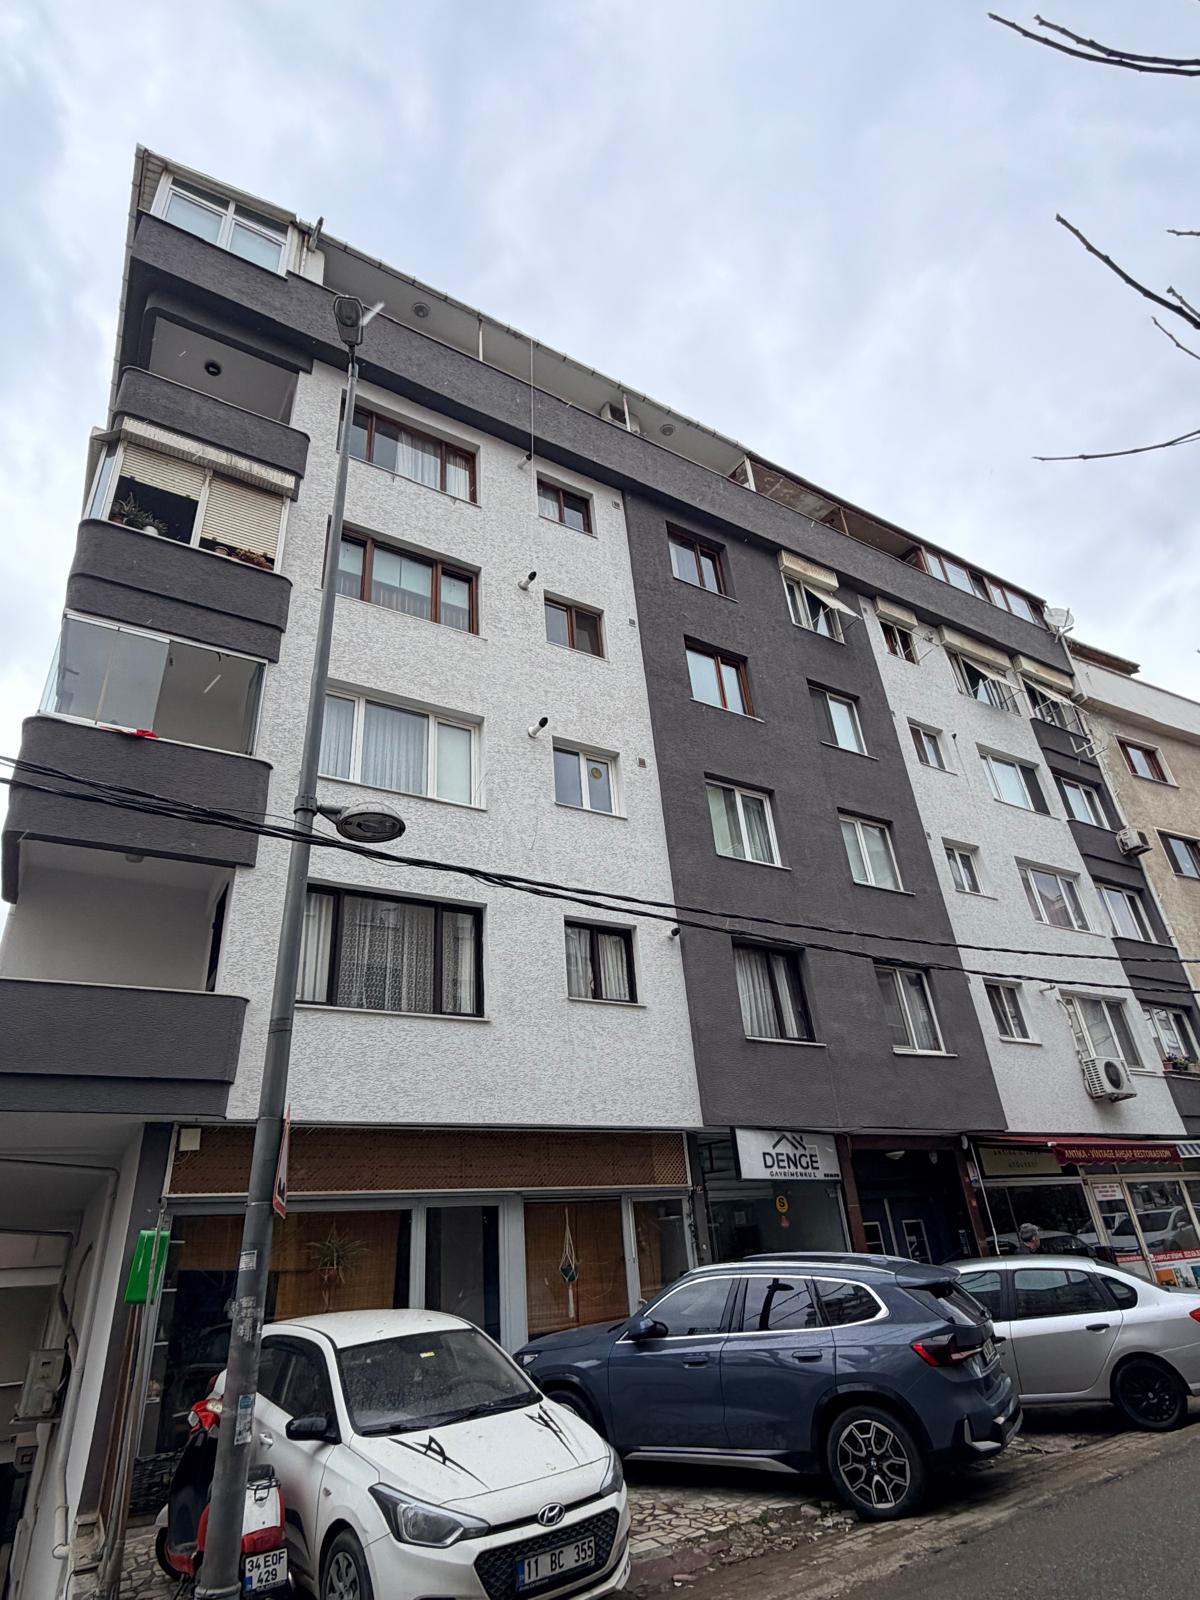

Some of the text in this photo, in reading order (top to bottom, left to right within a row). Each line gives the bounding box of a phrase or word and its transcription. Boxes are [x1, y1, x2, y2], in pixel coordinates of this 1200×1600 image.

[762, 1152, 820, 1170] DENGE
[769, 1170, 817, 1178] GAYRİMENKUL
[248, 1558, 261, 1572] 34
[527, 1539, 594, 1579] 11 BC 355
[257, 1568, 277, 1584] 429
